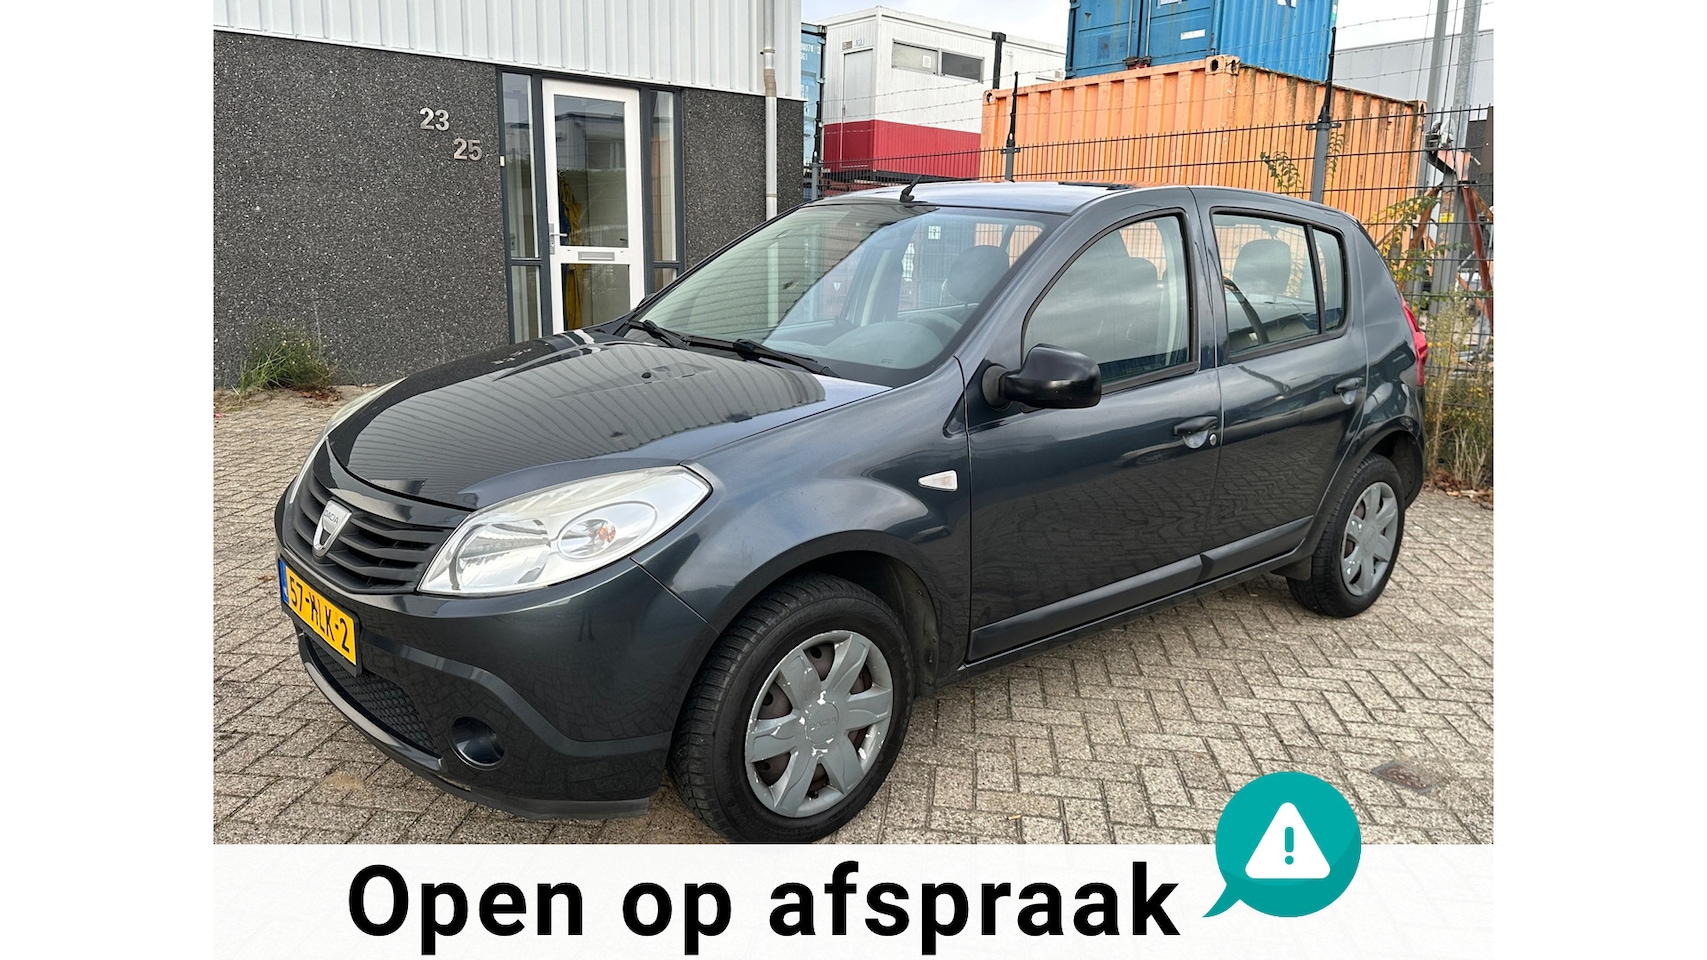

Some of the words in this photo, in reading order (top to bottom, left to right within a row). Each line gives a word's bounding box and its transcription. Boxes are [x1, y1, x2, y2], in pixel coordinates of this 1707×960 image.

[420, 107, 450, 131] 23
[453, 138, 483, 161] 25
[323, 509, 339, 524] DACIA
[289, 575, 350, 654] 57-HLK-2
